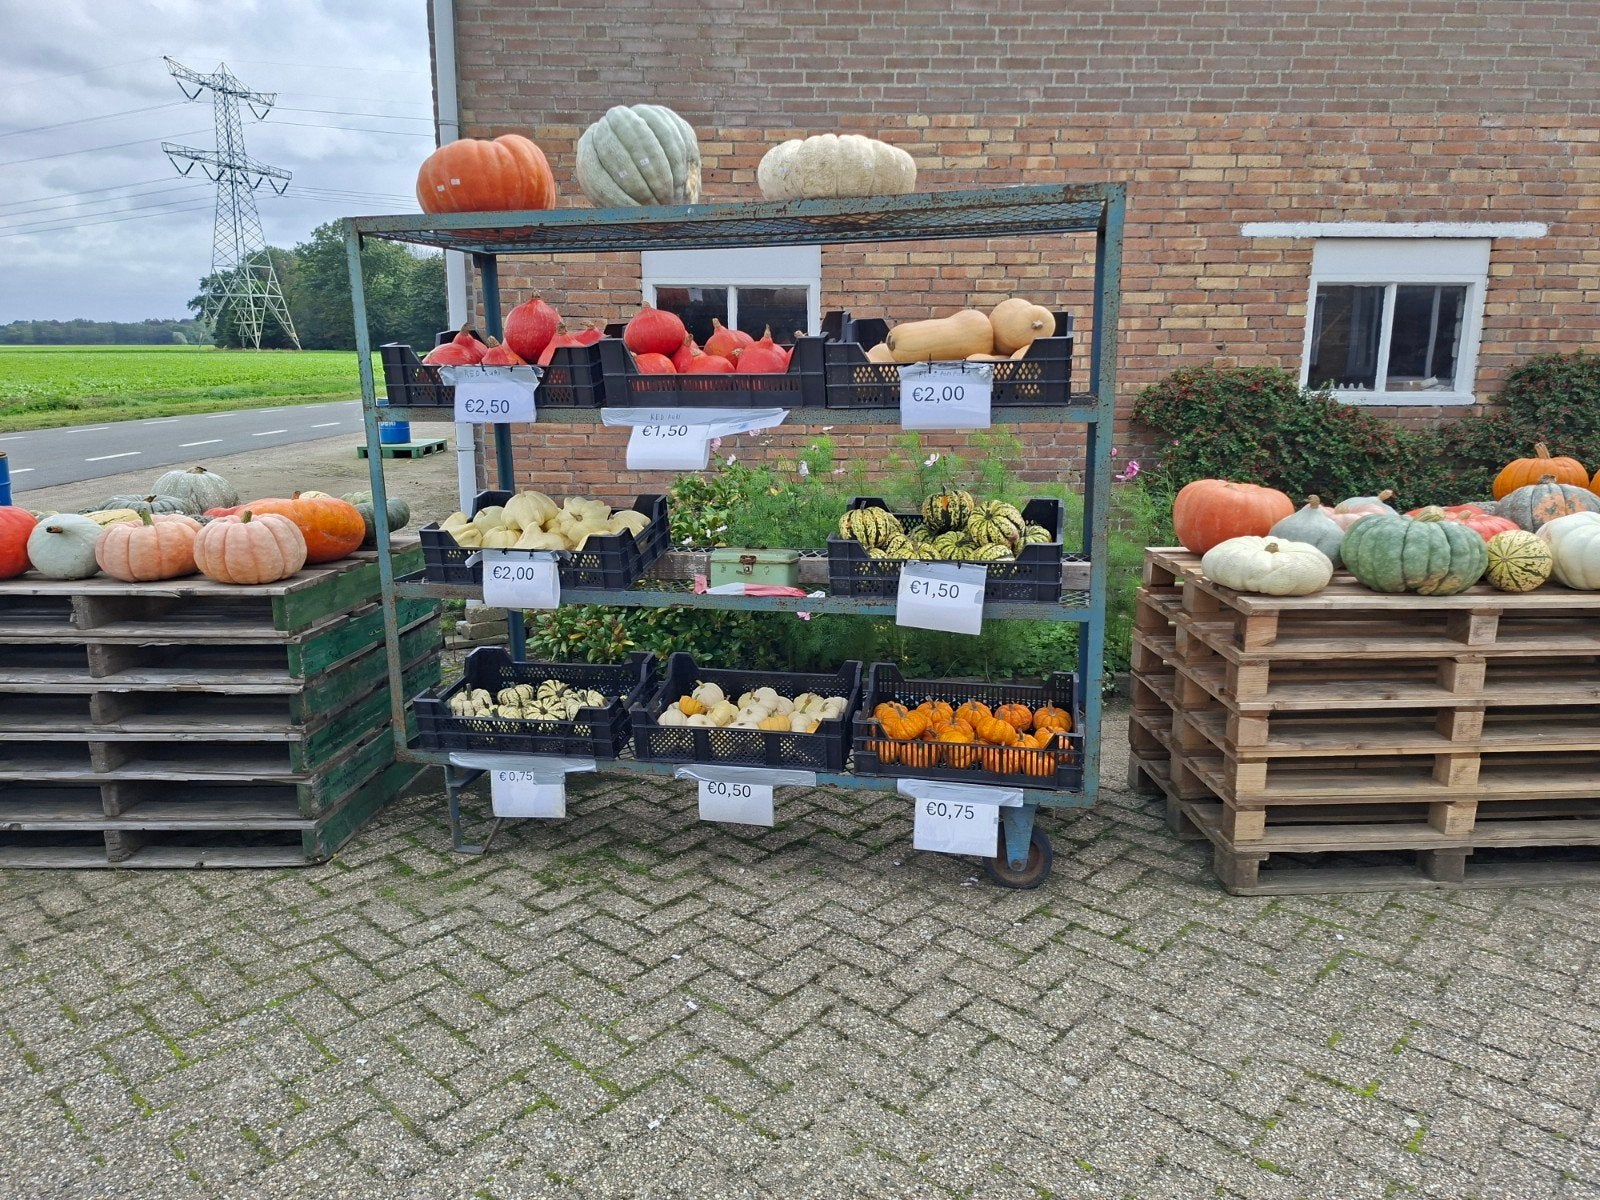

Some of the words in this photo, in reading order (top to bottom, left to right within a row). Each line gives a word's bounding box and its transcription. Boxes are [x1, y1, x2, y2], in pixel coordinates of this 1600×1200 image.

[912, 386, 965, 404] €2,00
[465, 399, 510, 415] €2,50
[642, 425, 688, 438] €1,50
[493, 565, 535, 582] €2,00
[910, 580, 960, 599] €1,50
[707, 781, 751, 798] €0,50
[926, 801, 974, 820] €0,75
